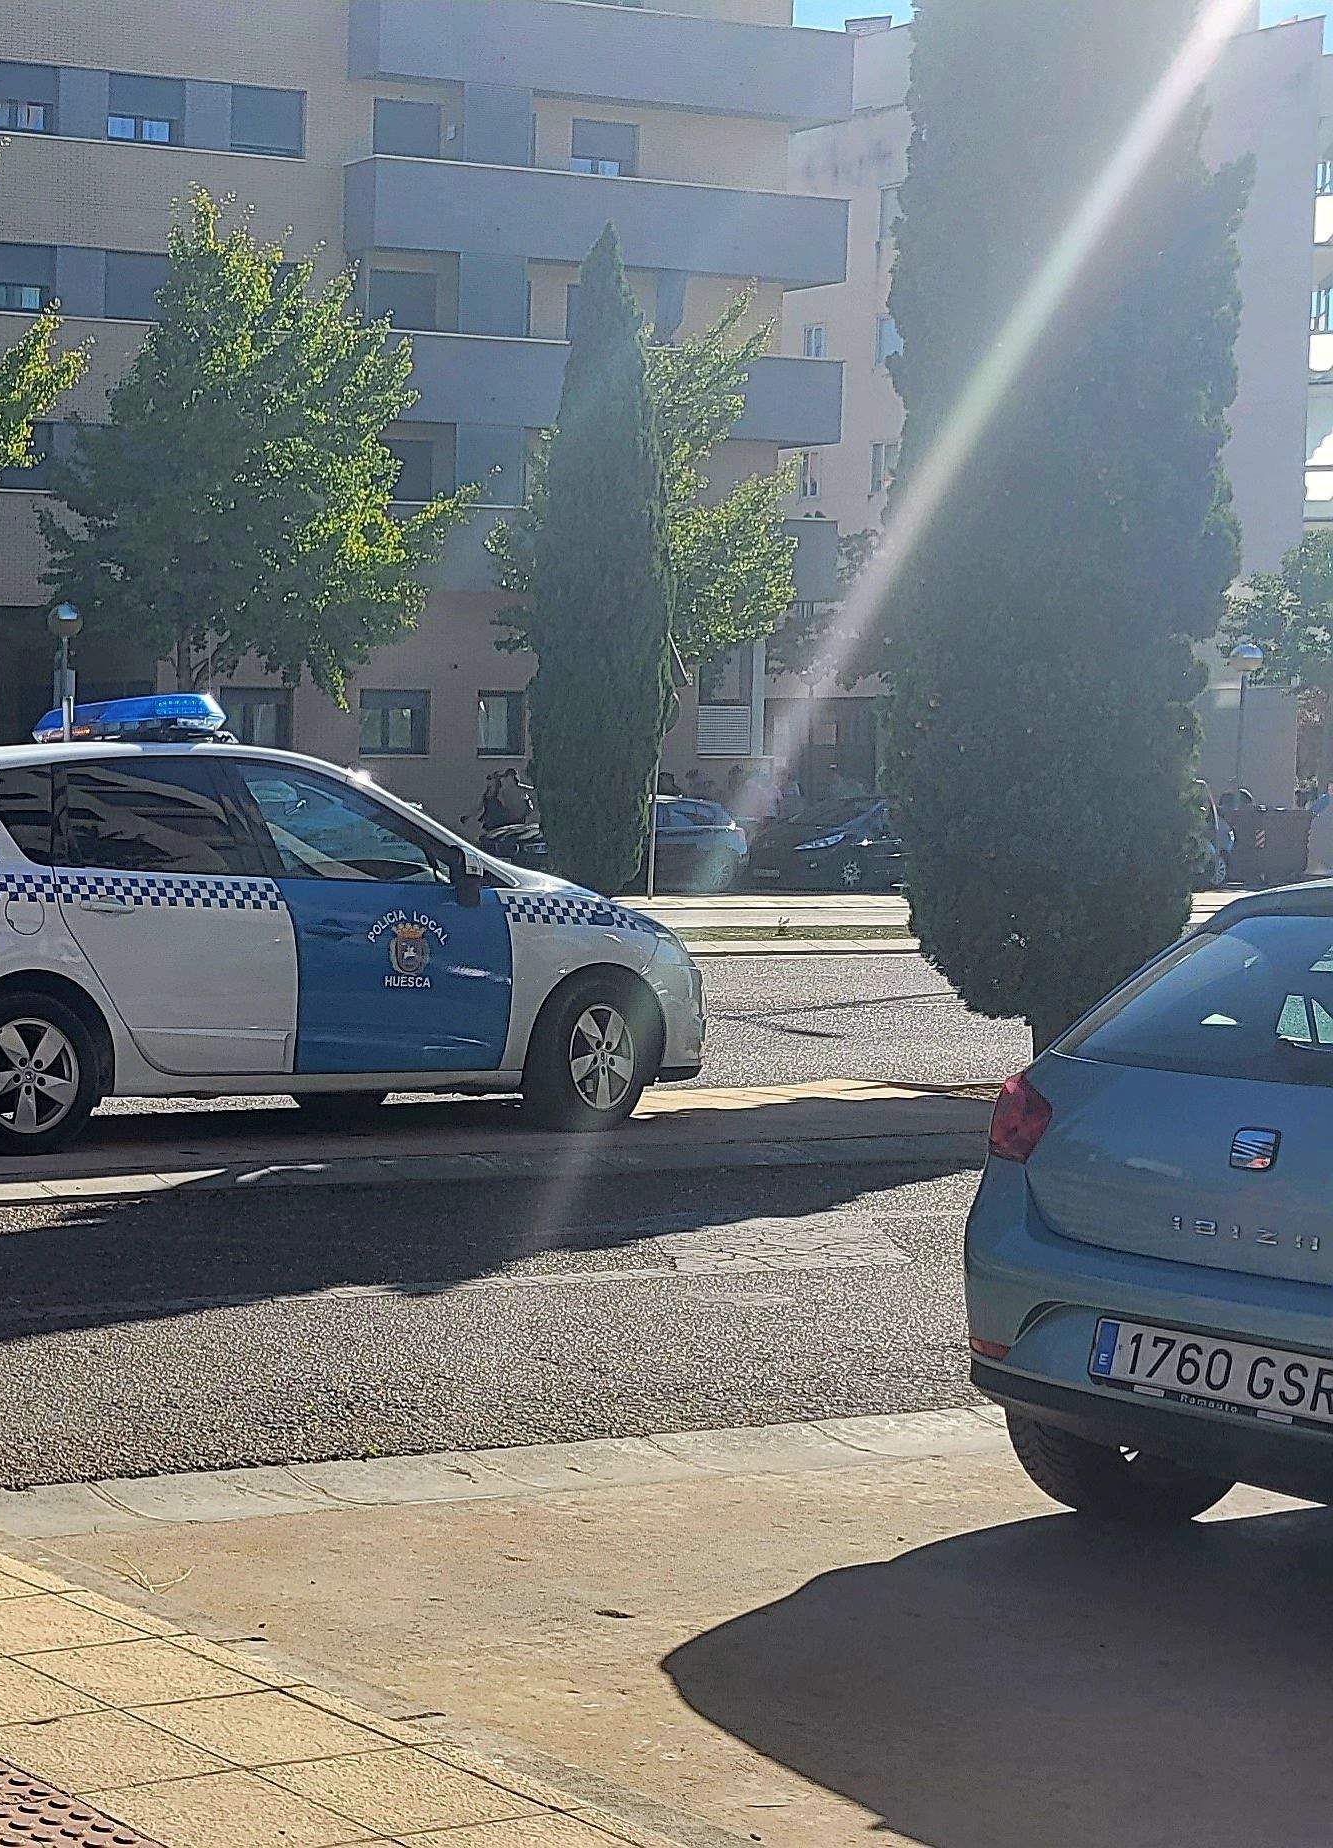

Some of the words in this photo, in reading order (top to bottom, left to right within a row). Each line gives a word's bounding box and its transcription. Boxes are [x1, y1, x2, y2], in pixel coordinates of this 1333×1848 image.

[413, 910, 448, 946] LOCAL
[384, 975, 431, 988] HUESCA
[1129, 1333, 1233, 1391] 1760
[1247, 1356, 1333, 1415] GSR
